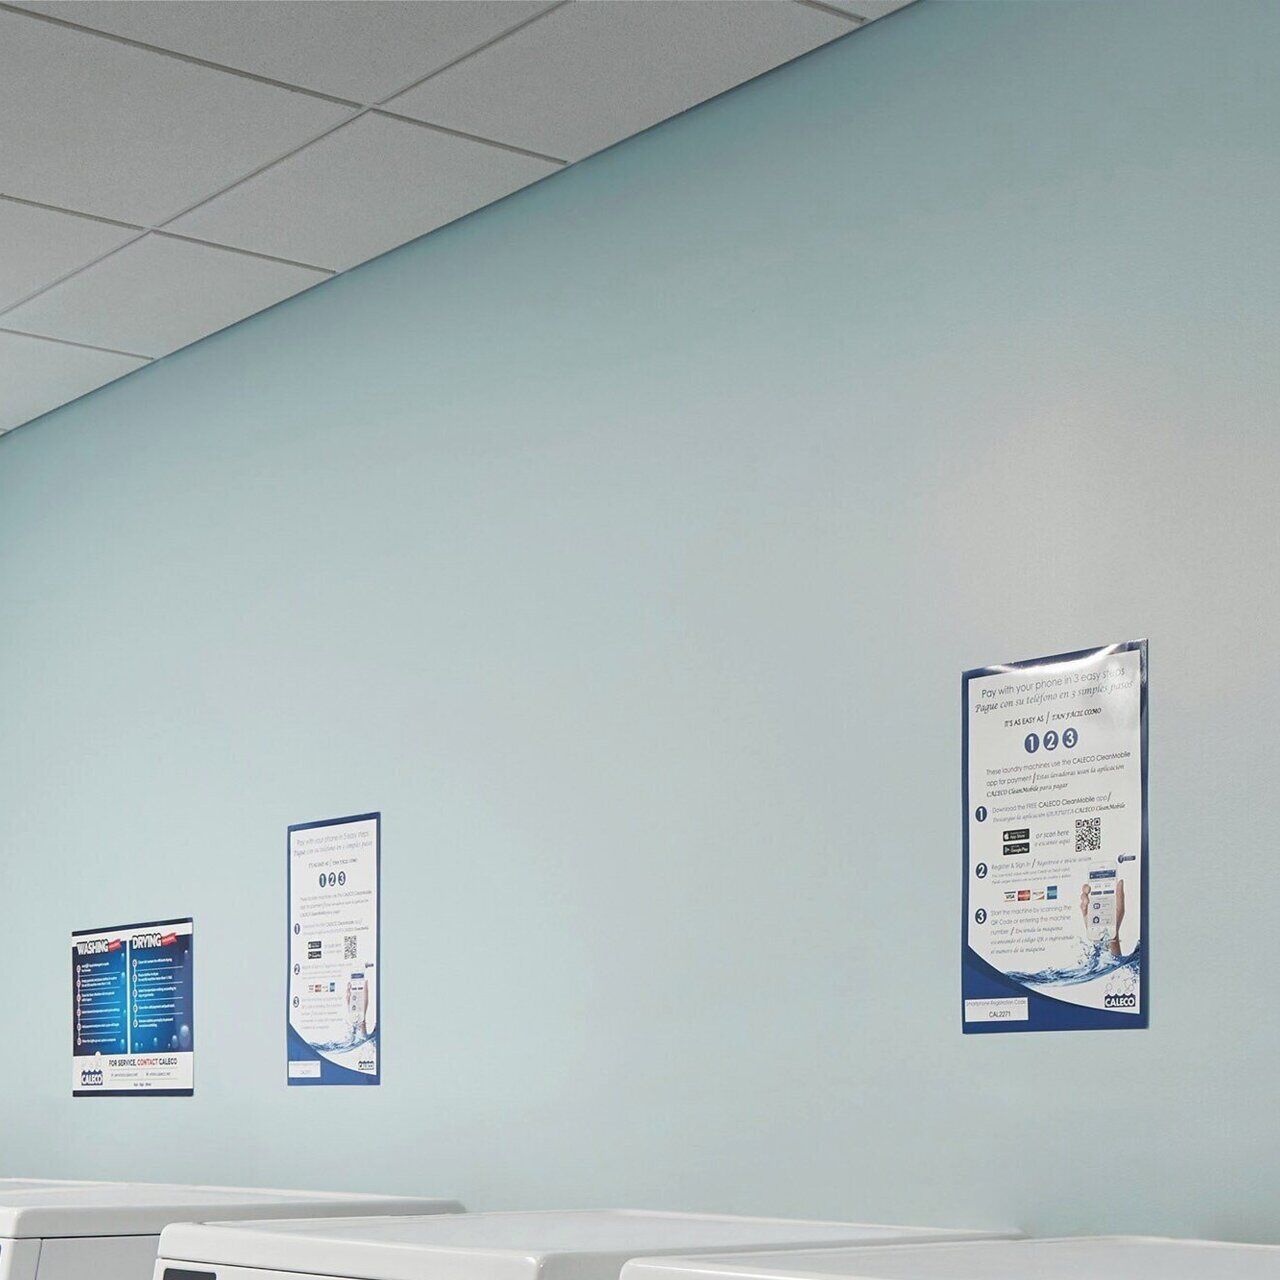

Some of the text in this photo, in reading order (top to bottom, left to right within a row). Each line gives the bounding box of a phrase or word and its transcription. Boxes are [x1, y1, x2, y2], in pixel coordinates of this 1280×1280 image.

[982, 688, 996, 699] Pay
[999, 685, 1014, 696] with
[1016, 683, 1034, 695] your
[1036, 678, 1062, 691] phone
[1065, 676, 1072, 684] in
[1074, 673, 1079, 682] 3
[1081, 672, 1102, 683] easy
[77, 940, 108, 955] WASHING
[133, 935, 161, 949] DRYING
[1105, 998, 1135, 1008] CALECO
